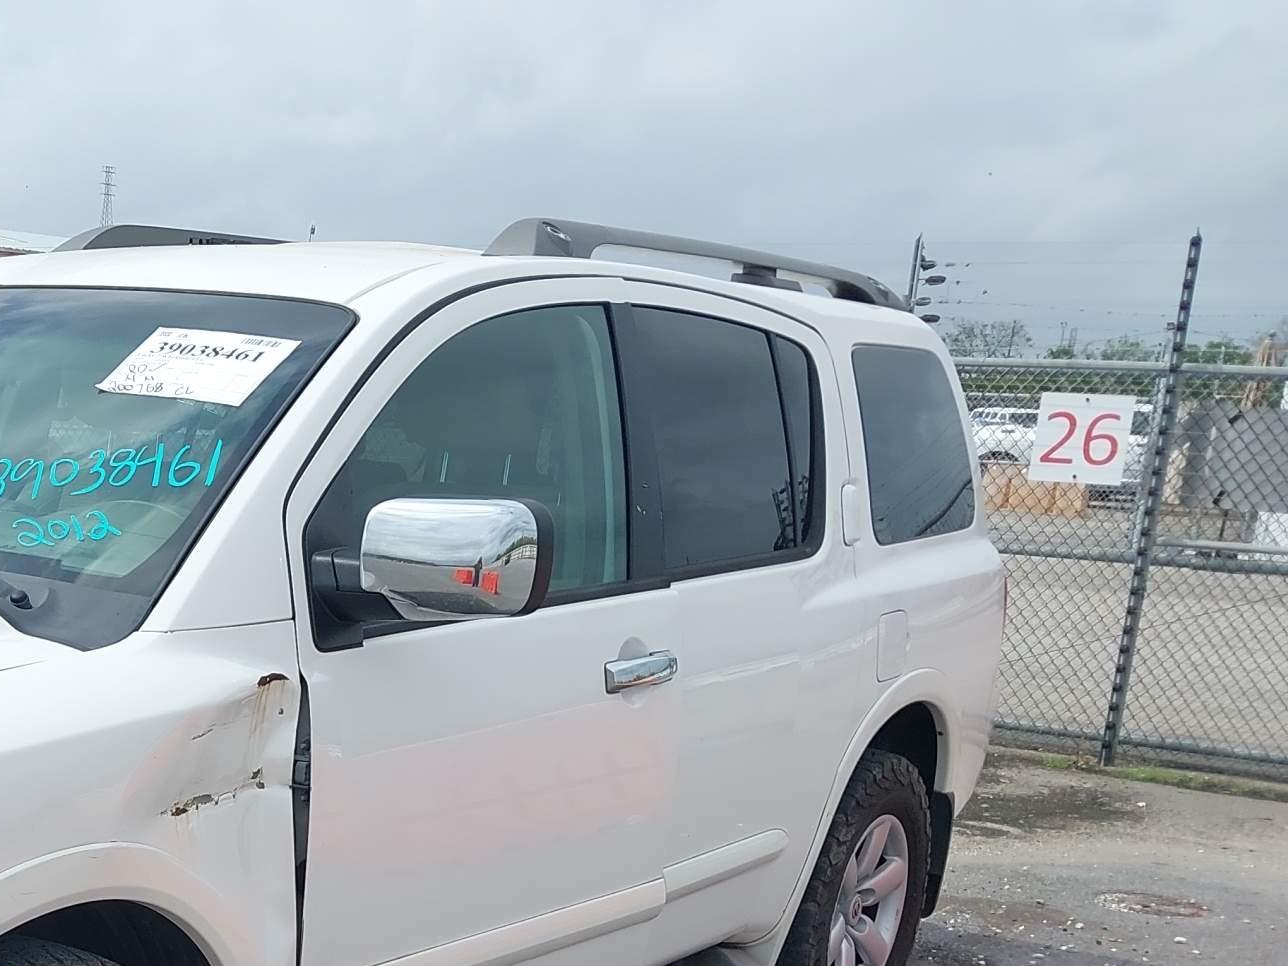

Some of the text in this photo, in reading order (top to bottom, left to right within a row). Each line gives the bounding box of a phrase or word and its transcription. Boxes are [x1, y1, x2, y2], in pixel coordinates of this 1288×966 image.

[150, 342, 265, 363] 39038461
[1040, 411, 1121, 466] 26
[12, 510, 122, 546] 2012
